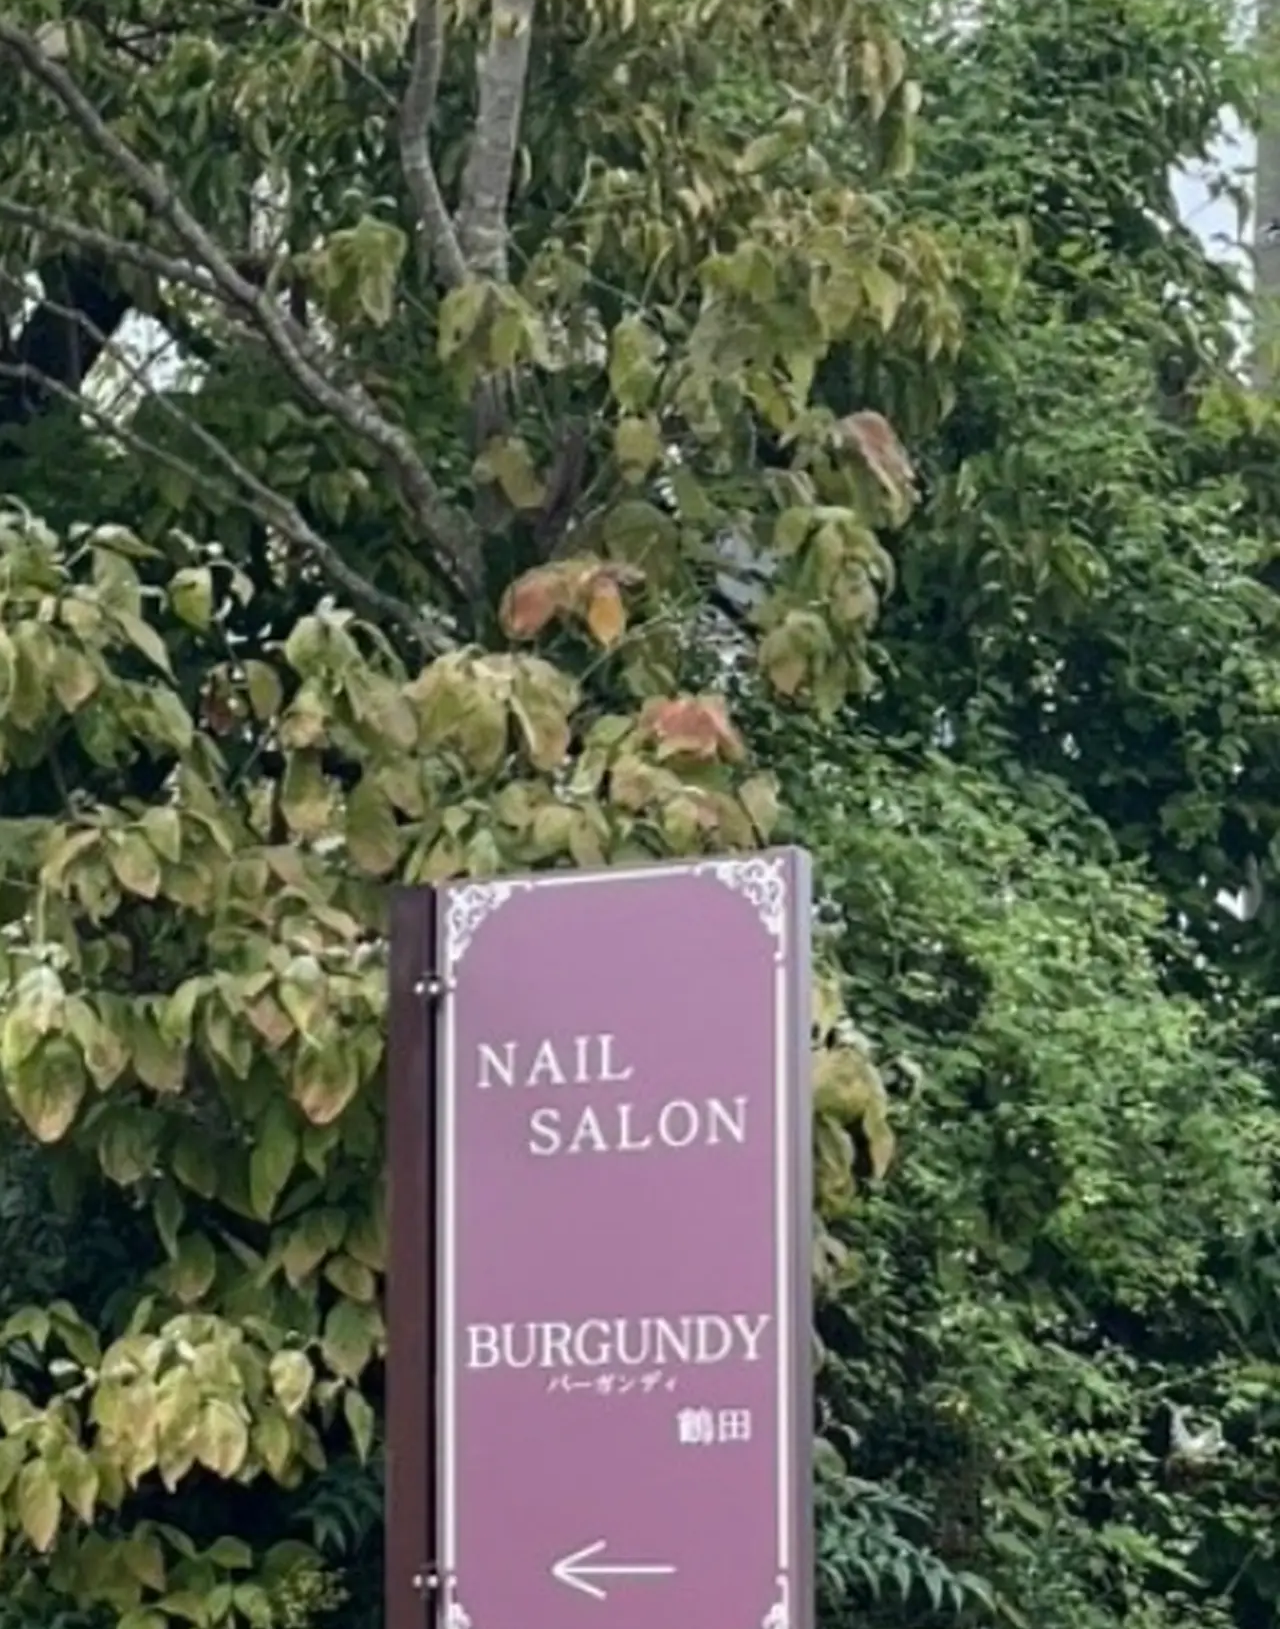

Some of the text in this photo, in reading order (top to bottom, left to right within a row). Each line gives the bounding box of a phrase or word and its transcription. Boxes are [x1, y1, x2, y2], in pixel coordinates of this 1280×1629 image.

[477, 1034, 633, 1089] NAIL
[528, 1096, 748, 1155] SALON
[466, 1314, 771, 1369] BURGUNDY
